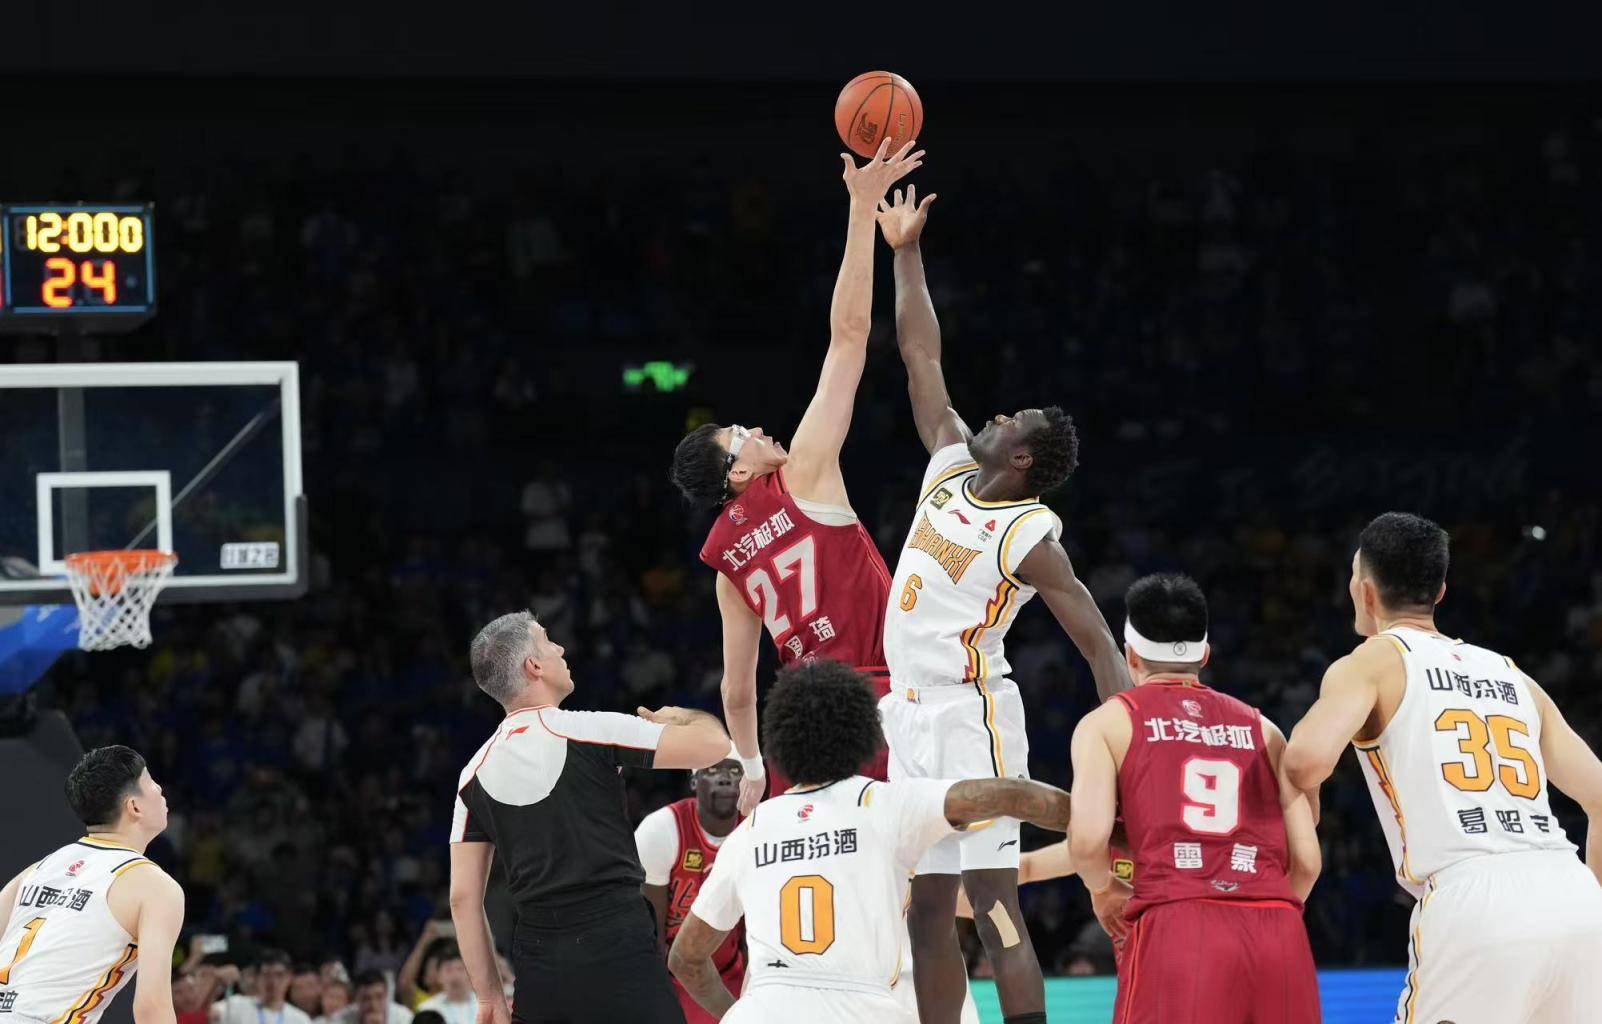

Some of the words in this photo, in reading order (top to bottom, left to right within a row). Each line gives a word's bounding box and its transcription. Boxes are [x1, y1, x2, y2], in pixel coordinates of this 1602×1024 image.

[42, 257, 117, 309] 24
[722, 507, 796, 572] 北汽极狐
[744, 533, 818, 641] 27
[899, 573, 923, 612] 6
[1426, 667, 1519, 706] 山西汾酒
[1144, 716, 1255, 750] 北汽极狐
[1434, 708, 1541, 800] 35
[1181, 757, 1241, 834] 9
[754, 827, 858, 869] 山西汾酒
[19, 884, 93, 912] 山西汾酒
[779, 874, 836, 956] 0
[0, 916, 47, 986] 1
